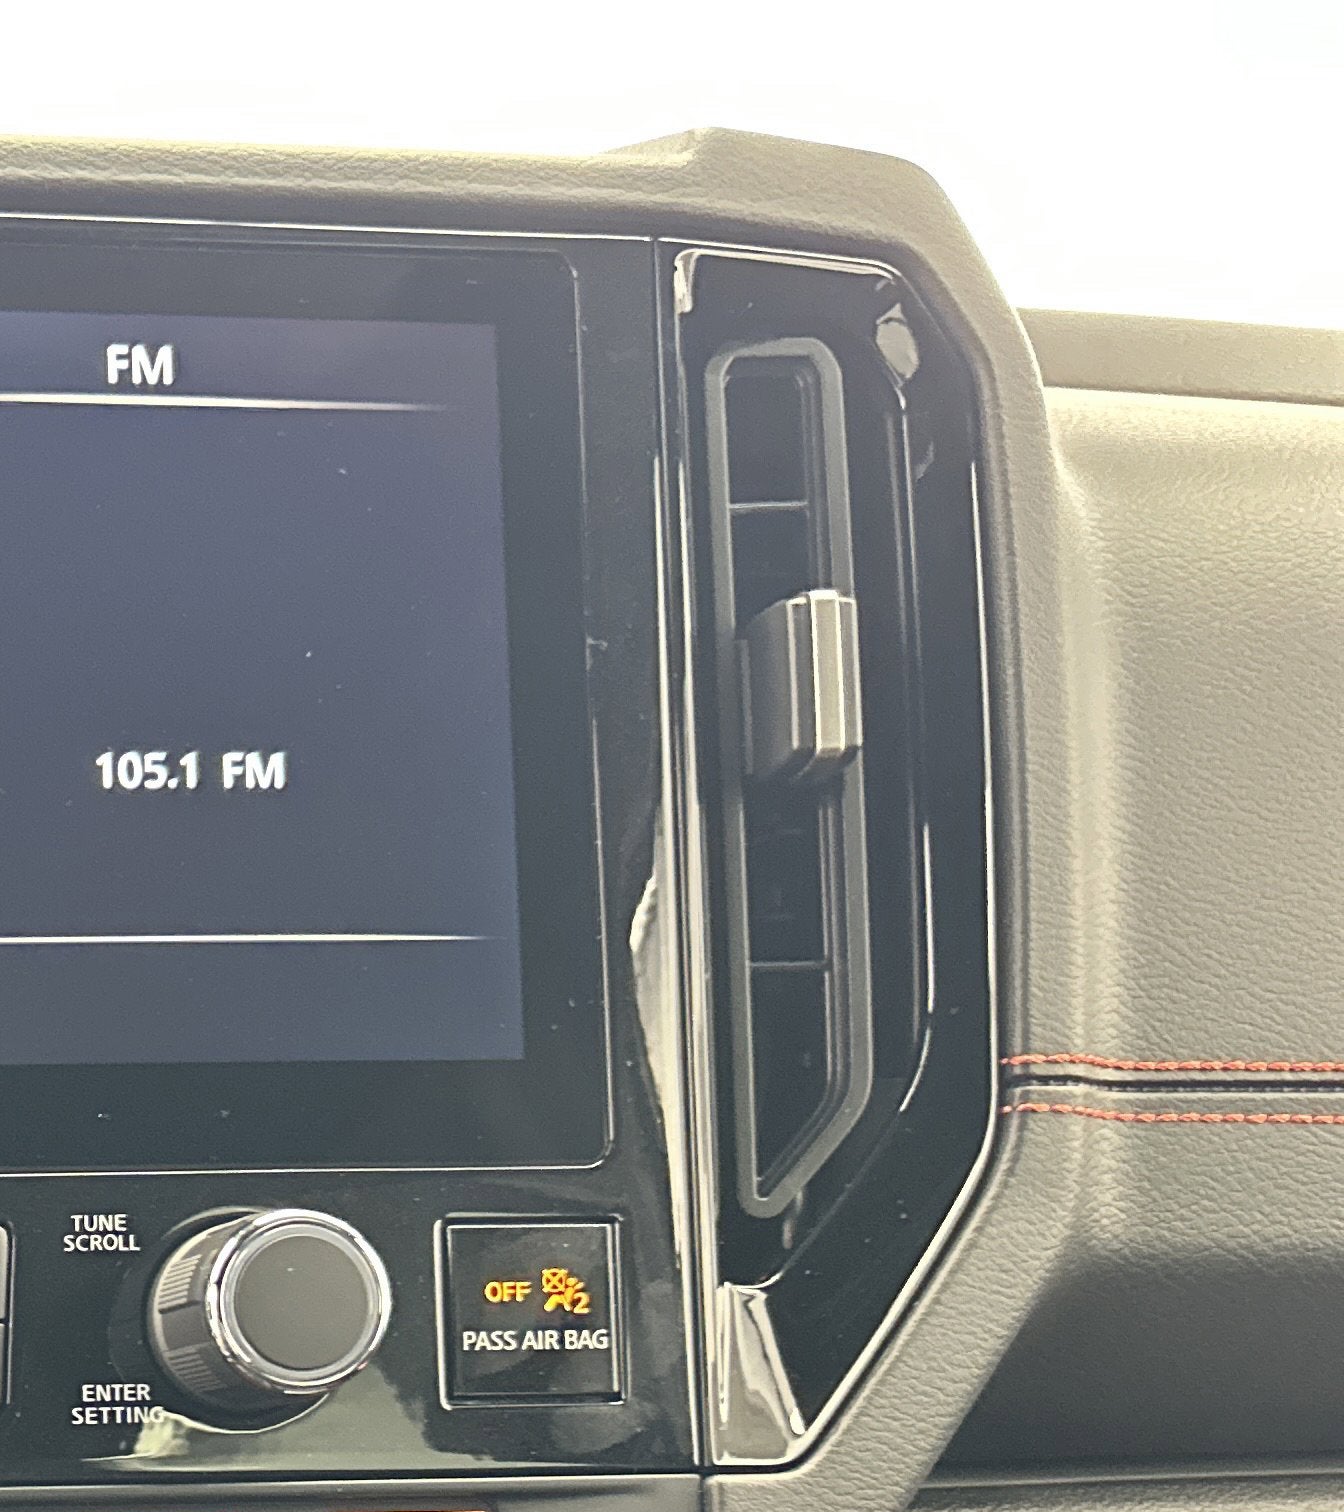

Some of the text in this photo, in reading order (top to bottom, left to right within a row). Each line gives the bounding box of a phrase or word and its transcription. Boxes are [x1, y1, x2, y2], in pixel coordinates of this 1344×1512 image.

[105, 344, 174, 387] FM
[95, 750, 287, 791] 105.1 FM
[71, 1214, 128, 1233] TUNE
[63, 1233, 140, 1252] SCROLL
[484, 1280, 532, 1303] OFF
[462, 1328, 610, 1351] PASS AIR BAG
[81, 1383, 151, 1403] ENTER
[71, 1404, 165, 1426] SETTING
